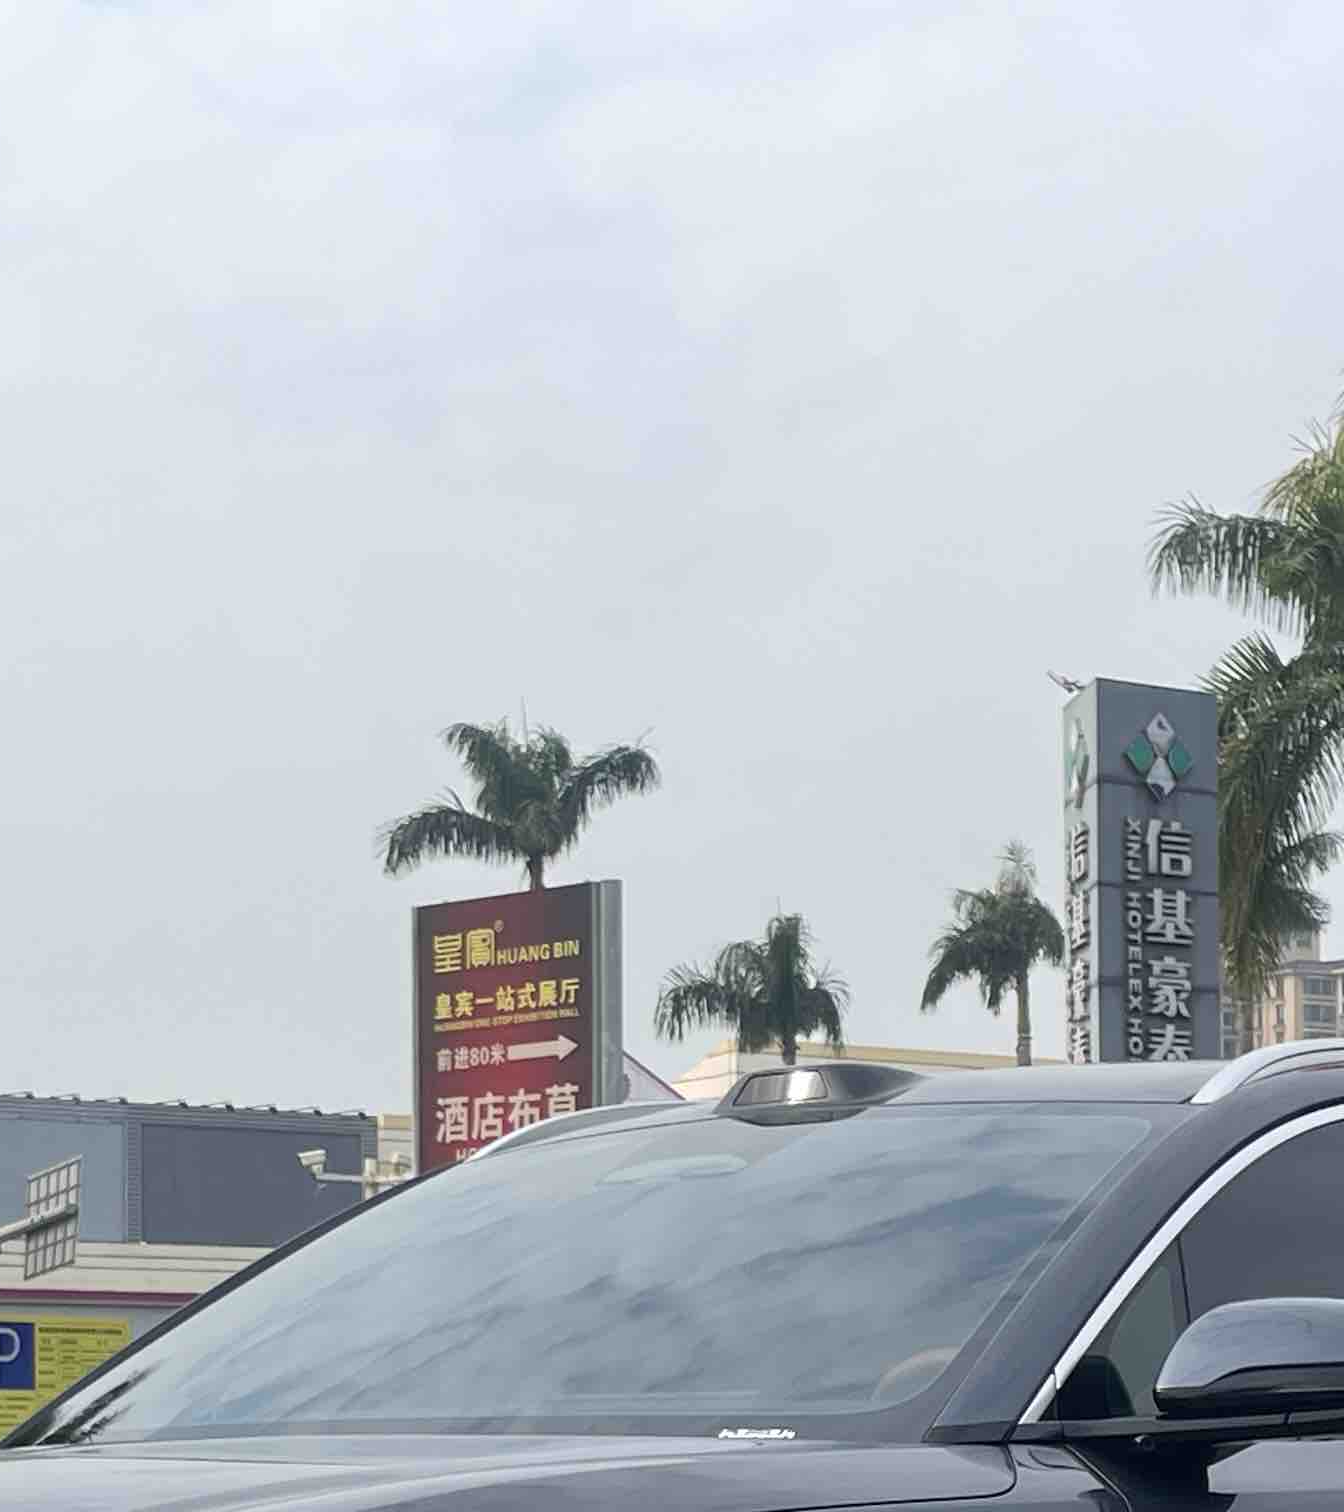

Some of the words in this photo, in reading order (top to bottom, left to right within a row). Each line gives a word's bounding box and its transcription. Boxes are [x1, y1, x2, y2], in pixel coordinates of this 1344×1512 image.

[1126, 817, 1143, 881] XINJI
[496, 943, 550, 966] HUANG
[552, 939, 580, 959] BIN
[434, 977, 581, 1020] 皇宾一站式展厅
[436, 1043, 506, 1073] 前进80米
